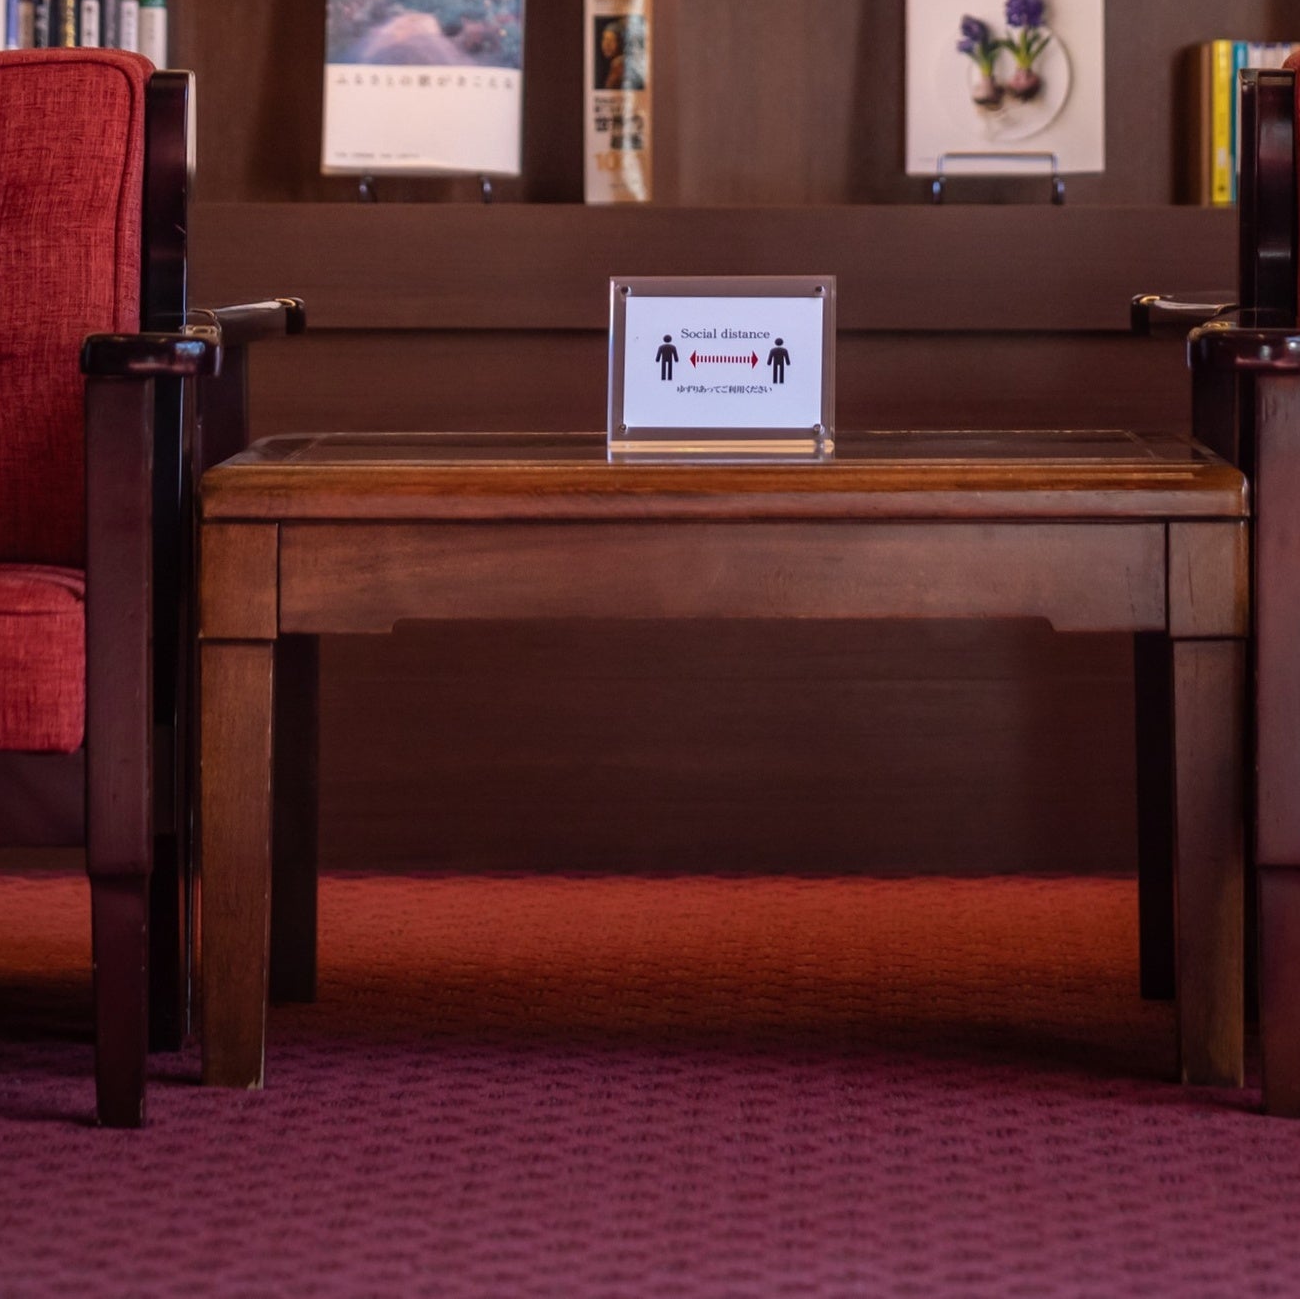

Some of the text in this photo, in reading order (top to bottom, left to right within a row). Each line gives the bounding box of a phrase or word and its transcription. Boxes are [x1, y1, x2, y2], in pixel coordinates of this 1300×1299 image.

[680, 328, 771, 340] Social distance
[676, 385, 773, 395] ゆずりあってご利用ください
